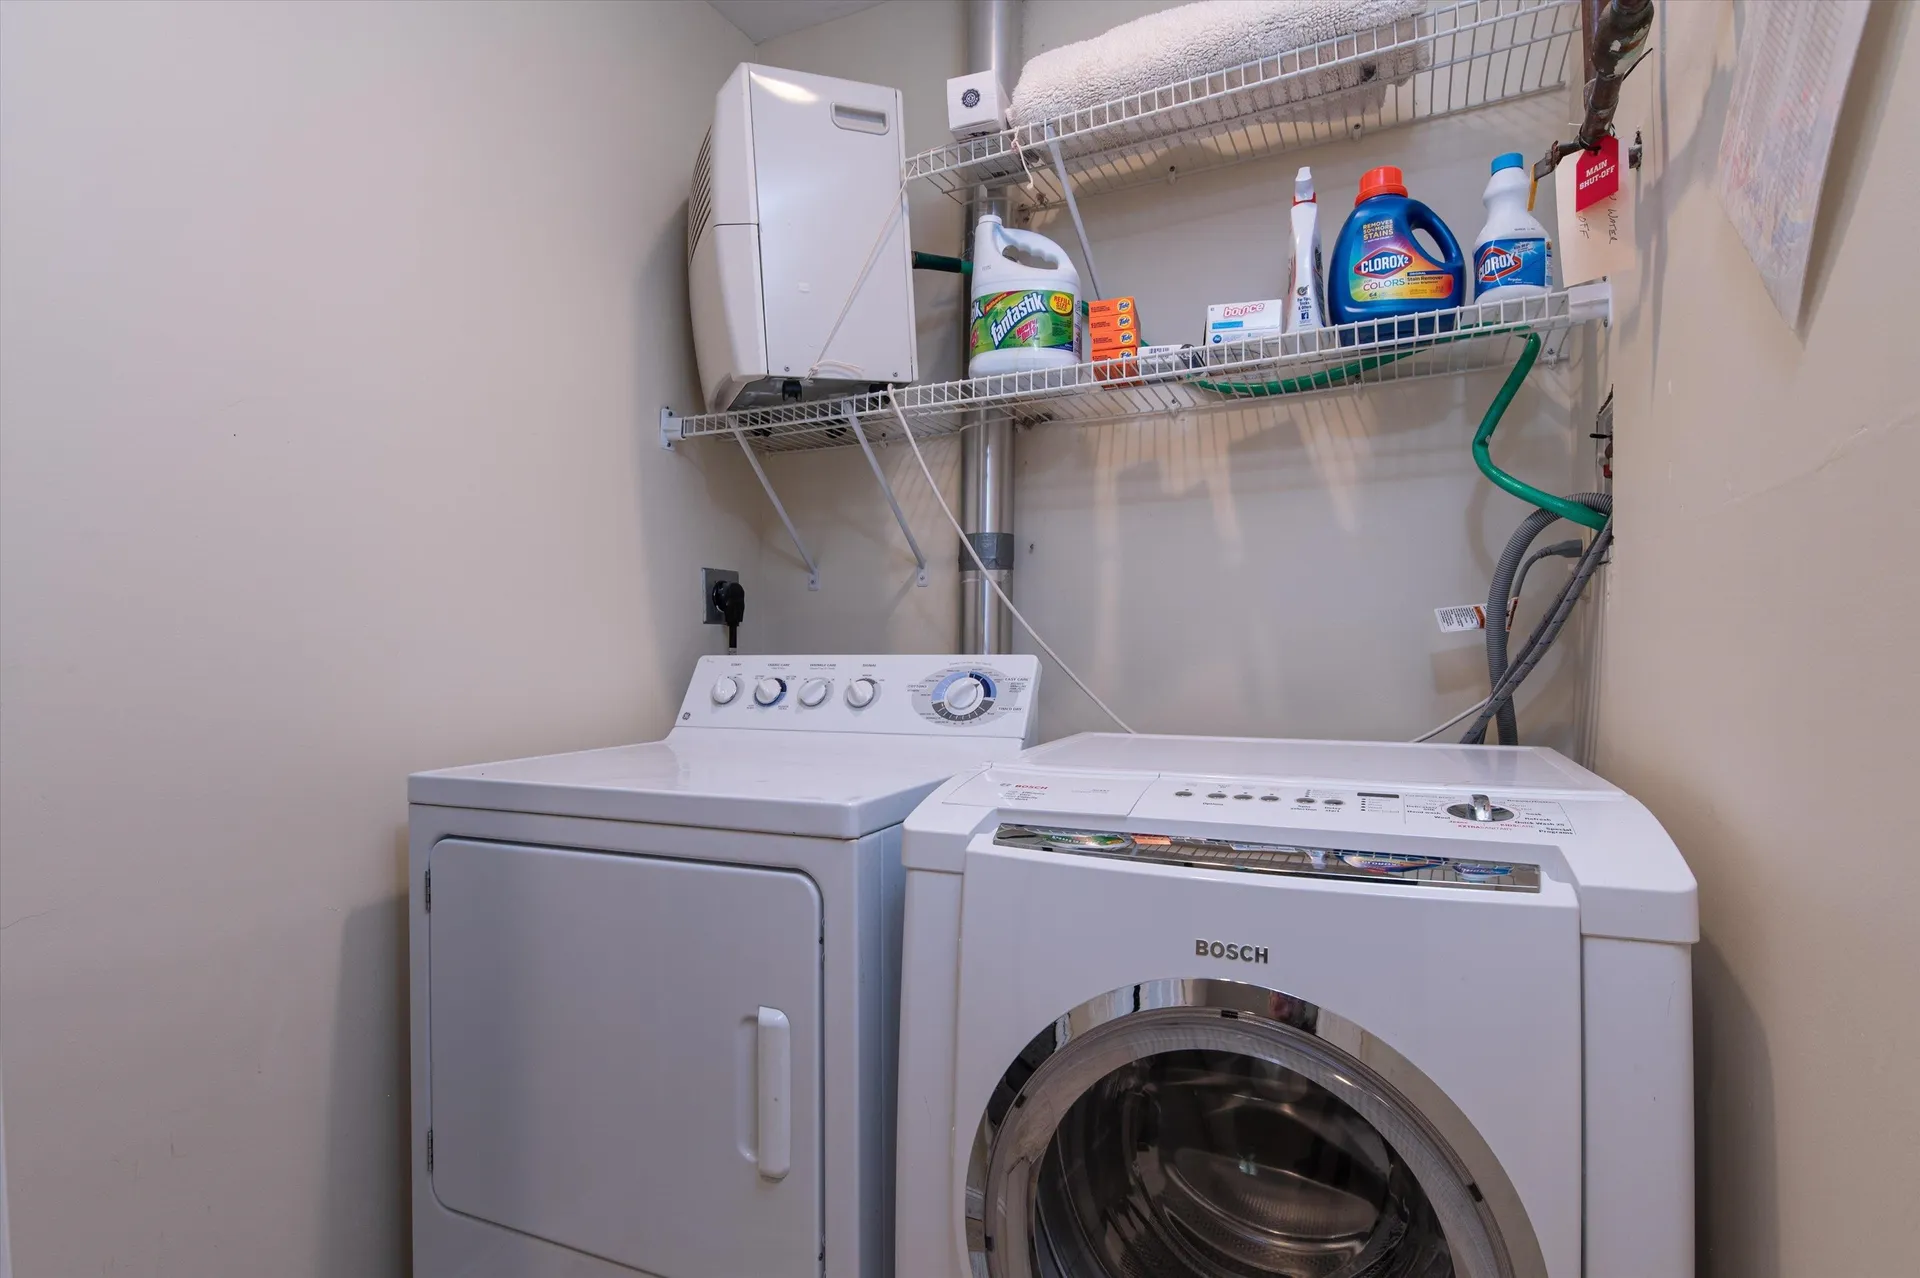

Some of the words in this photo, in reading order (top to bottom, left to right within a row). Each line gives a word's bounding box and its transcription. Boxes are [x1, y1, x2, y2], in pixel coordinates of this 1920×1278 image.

[1586, 159, 1608, 177] MAIN
[1579, 165, 1616, 190] SHUT-OFF
[1362, 219, 1393, 230] REMOVES
[1375, 224, 1394, 232] MORE
[1608, 208, 1619, 245] WATER
[1363, 229, 1394, 241] STAINS
[1363, 278, 1405, 292] COLORS
[1053, 296, 1071, 305] REFILL
[1118, 302, 1130, 310] Tide
[1223, 303, 1265, 318] bounce
[991, 292, 1048, 348] fantastik
[1119, 317, 1130, 326] Tide
[1121, 335, 1132, 343] Tide
[1194, 938, 1269, 965] BOSCH
